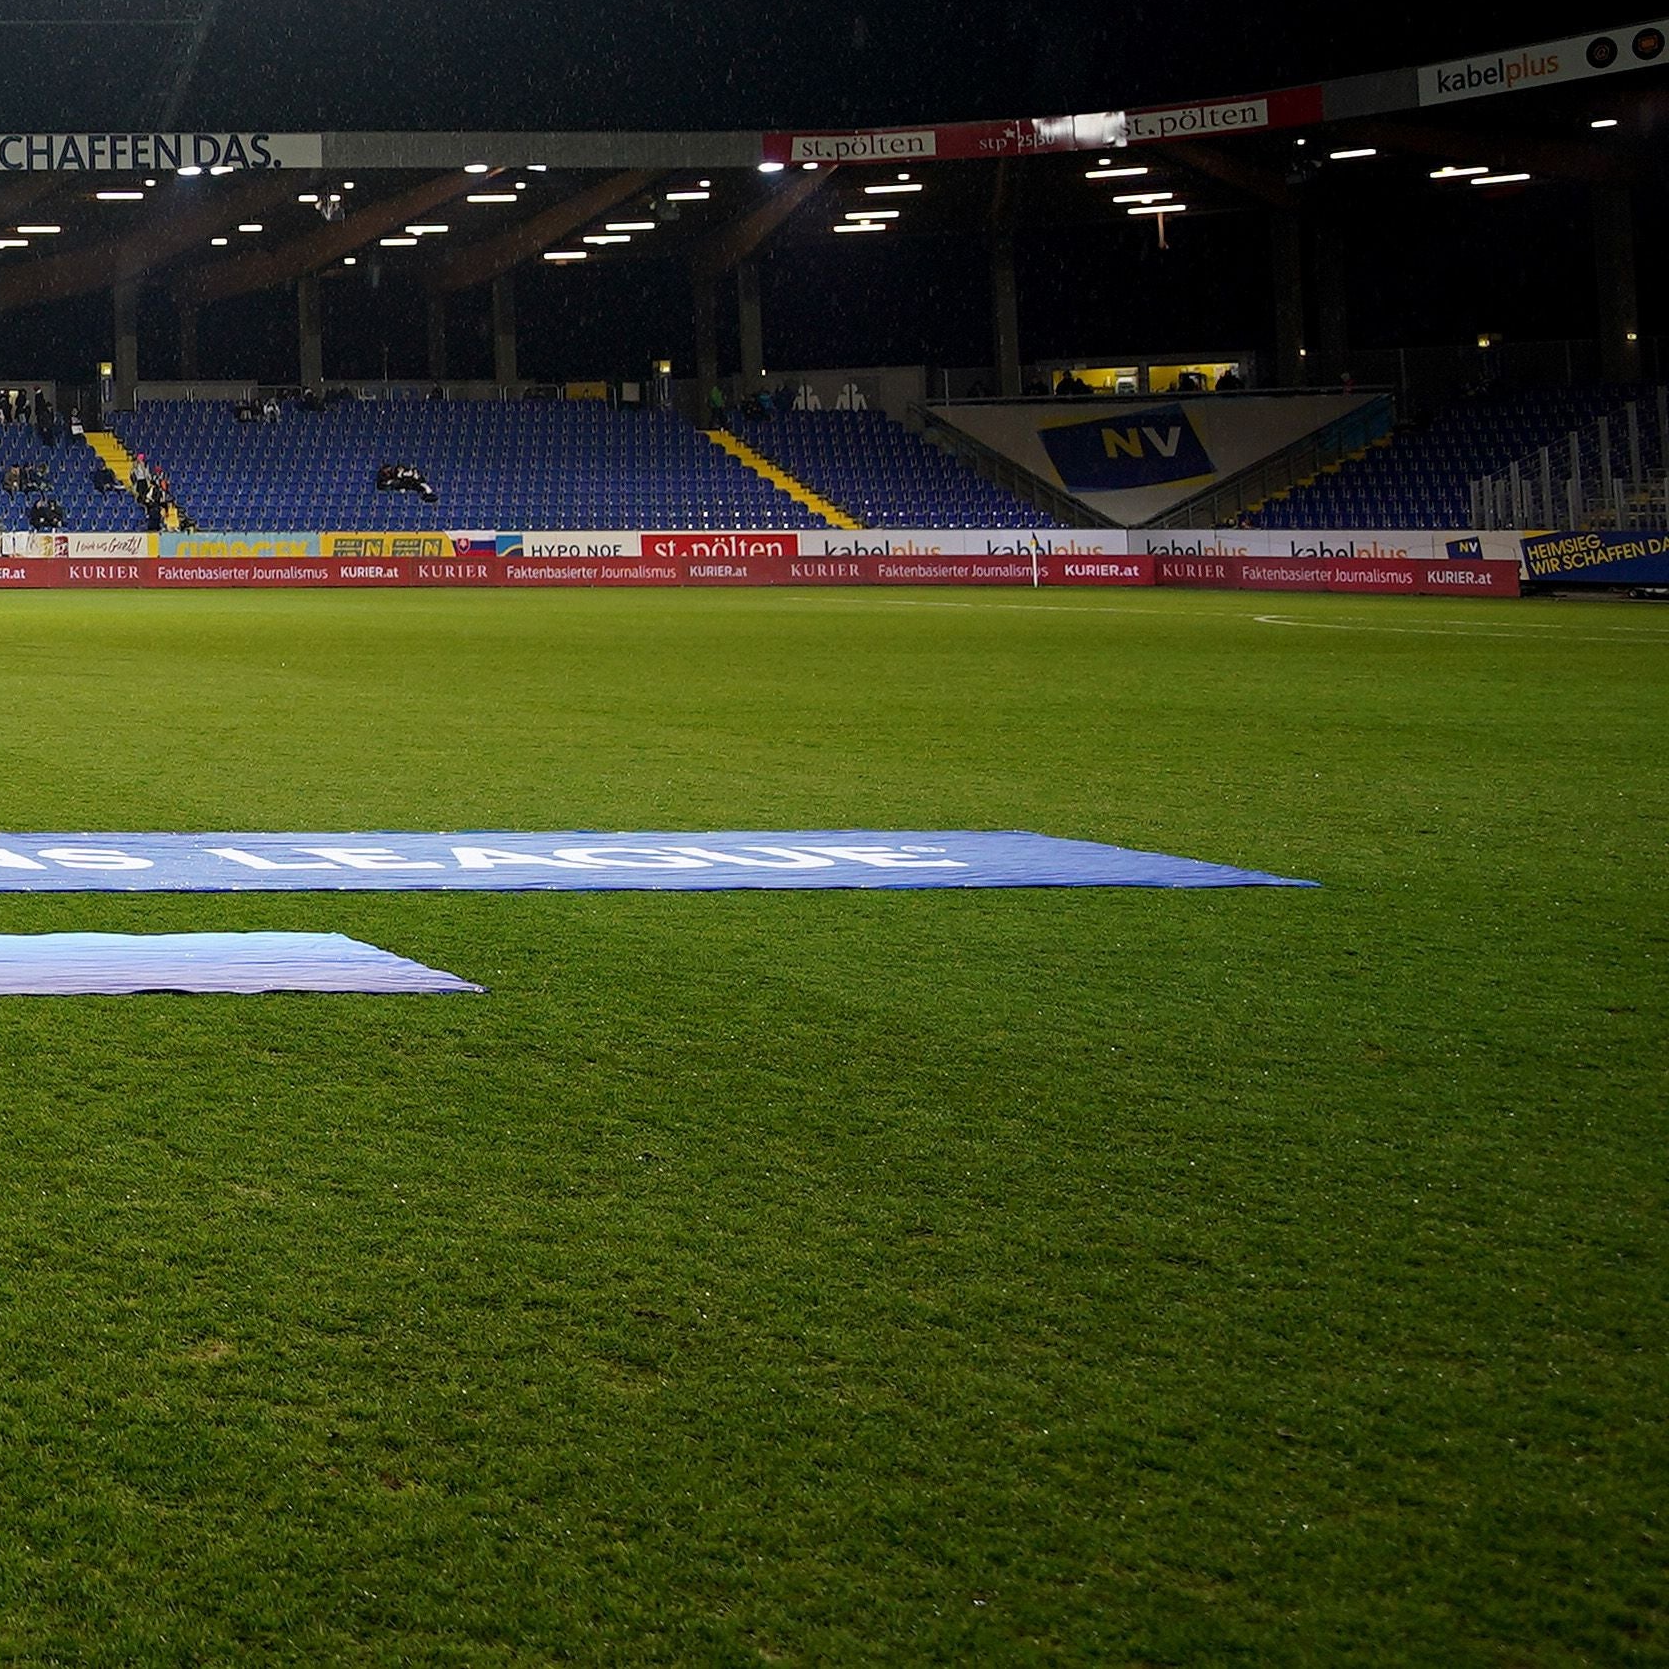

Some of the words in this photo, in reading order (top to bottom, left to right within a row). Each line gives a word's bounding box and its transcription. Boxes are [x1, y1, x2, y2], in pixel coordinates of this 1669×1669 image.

[1437, 53, 1559, 93] kabelplus
[193, 134, 282, 171] DAS.
[1101, 426, 1181, 458] NV
[1458, 542, 1478, 553] NV
[1527, 533, 1607, 562] HEIMSIEG.
[1530, 559, 1559, 577] WIR
[1561, 539, 1647, 572] SCHAFFEN
[1649, 536, 1669, 555] DA
[68, 565, 140, 579] KURIER
[157, 565, 250, 581] Faktenbasierter
[251, 565, 329, 581] Journalismus
[340, 565, 400, 579] KURIER.at
[418, 564, 489, 578] KURIER
[506, 565, 598, 580] Faktenbasierter
[599, 565, 677, 581] Journalismus
[689, 565, 748, 578] KURIER.at
[790, 564, 860, 578] KURIER
[877, 563, 970, 579] Faktenbasierter
[1064, 563, 1140, 577] KURIER.at
[1162, 563, 1226, 579] KURIER
[1242, 565, 1333, 583] Faktenbasierter
[1334, 567, 1413, 585] Journalismus
[1427, 569, 1493, 585] KURIER.at
